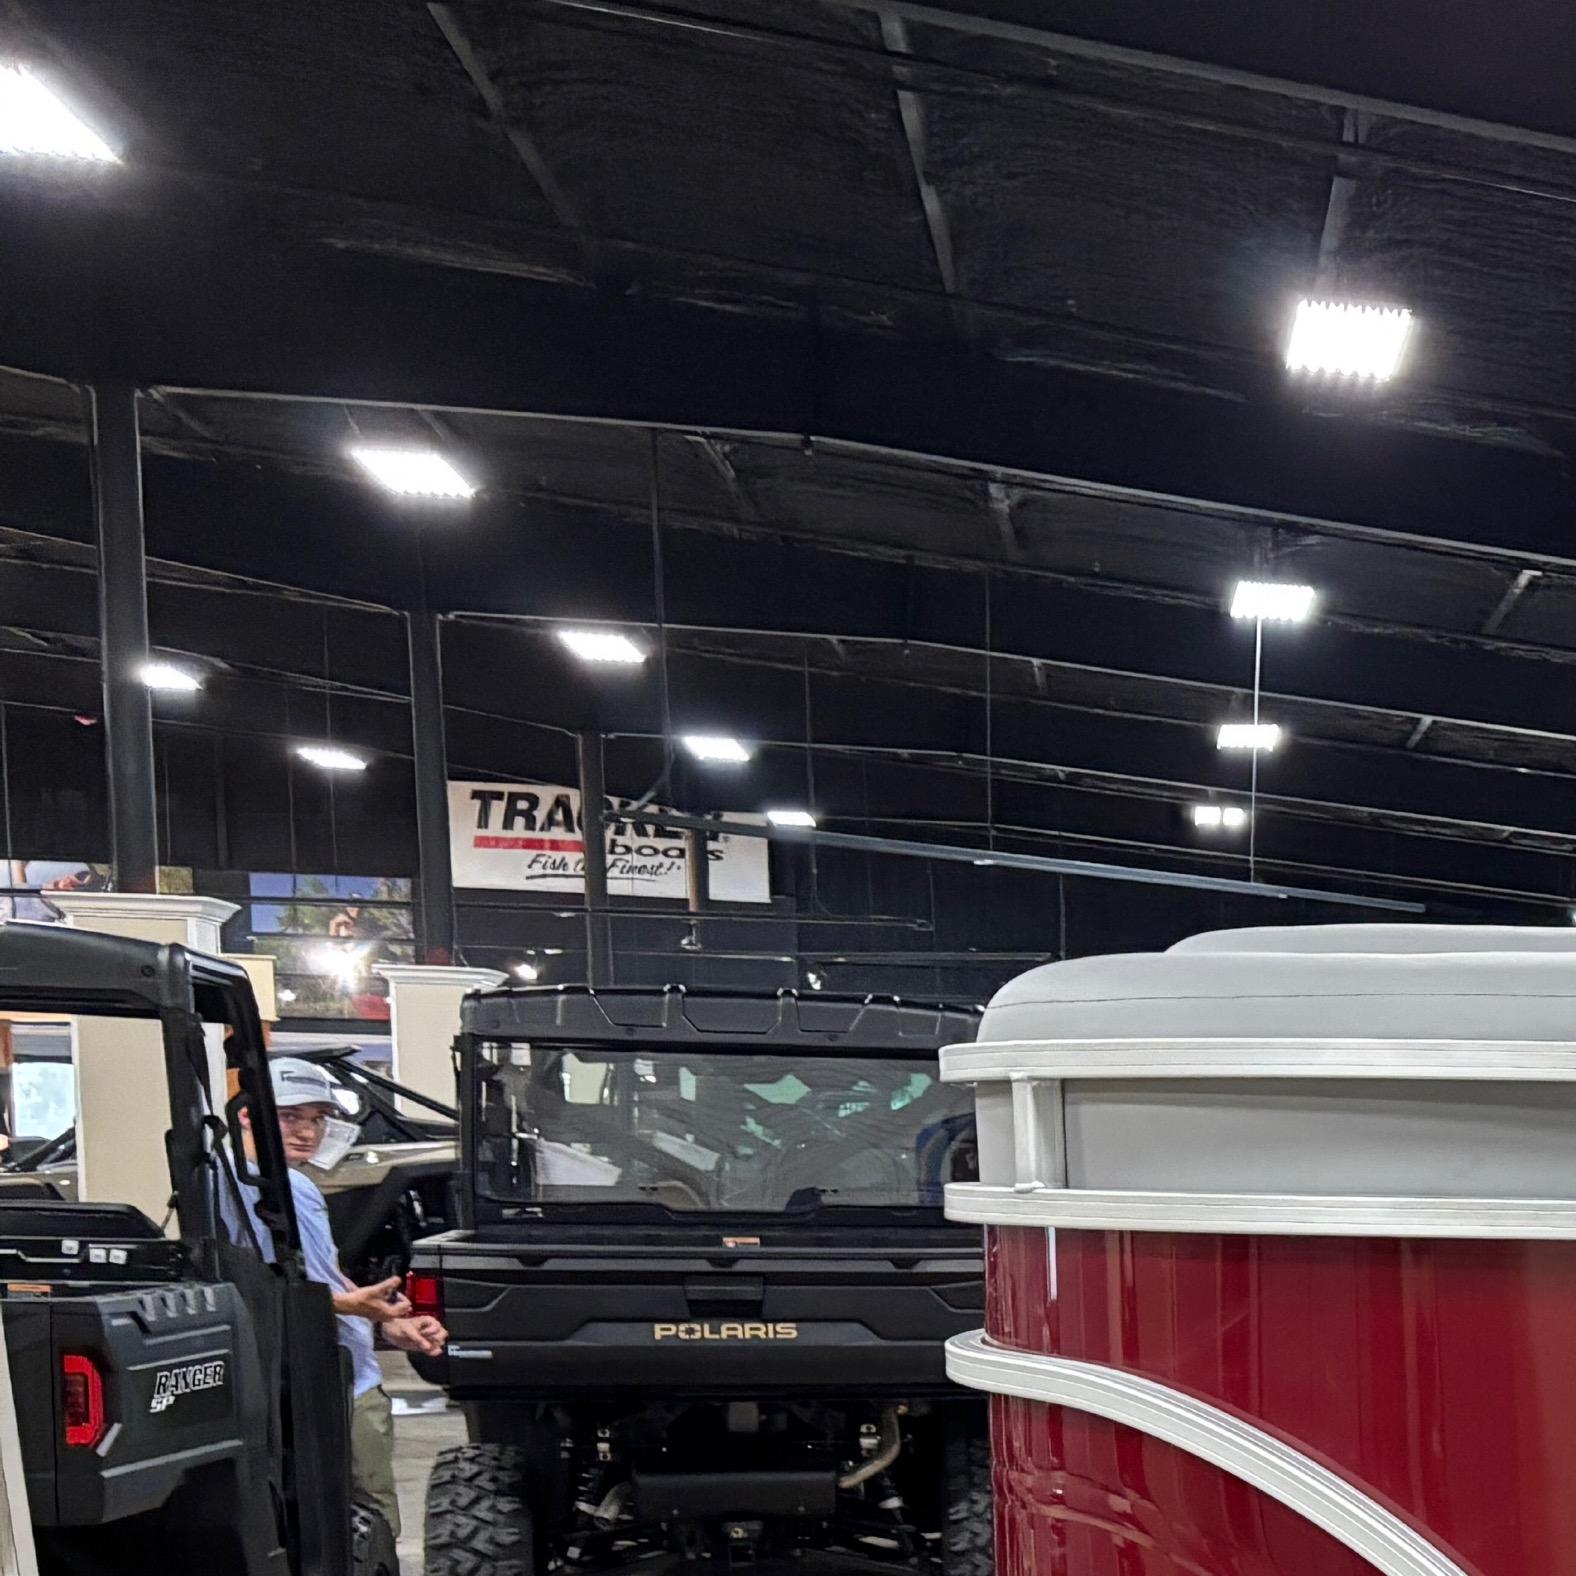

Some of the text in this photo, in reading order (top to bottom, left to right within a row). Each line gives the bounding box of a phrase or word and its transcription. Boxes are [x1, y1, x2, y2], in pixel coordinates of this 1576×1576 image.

[470, 789, 722, 841] TRAK
[608, 838, 723, 861] boas
[527, 853, 569, 872] Fish
[654, 1323, 798, 1340] POLARIS
[154, 1361, 225, 1398] RANGER
[149, 1395, 176, 1413] SP
